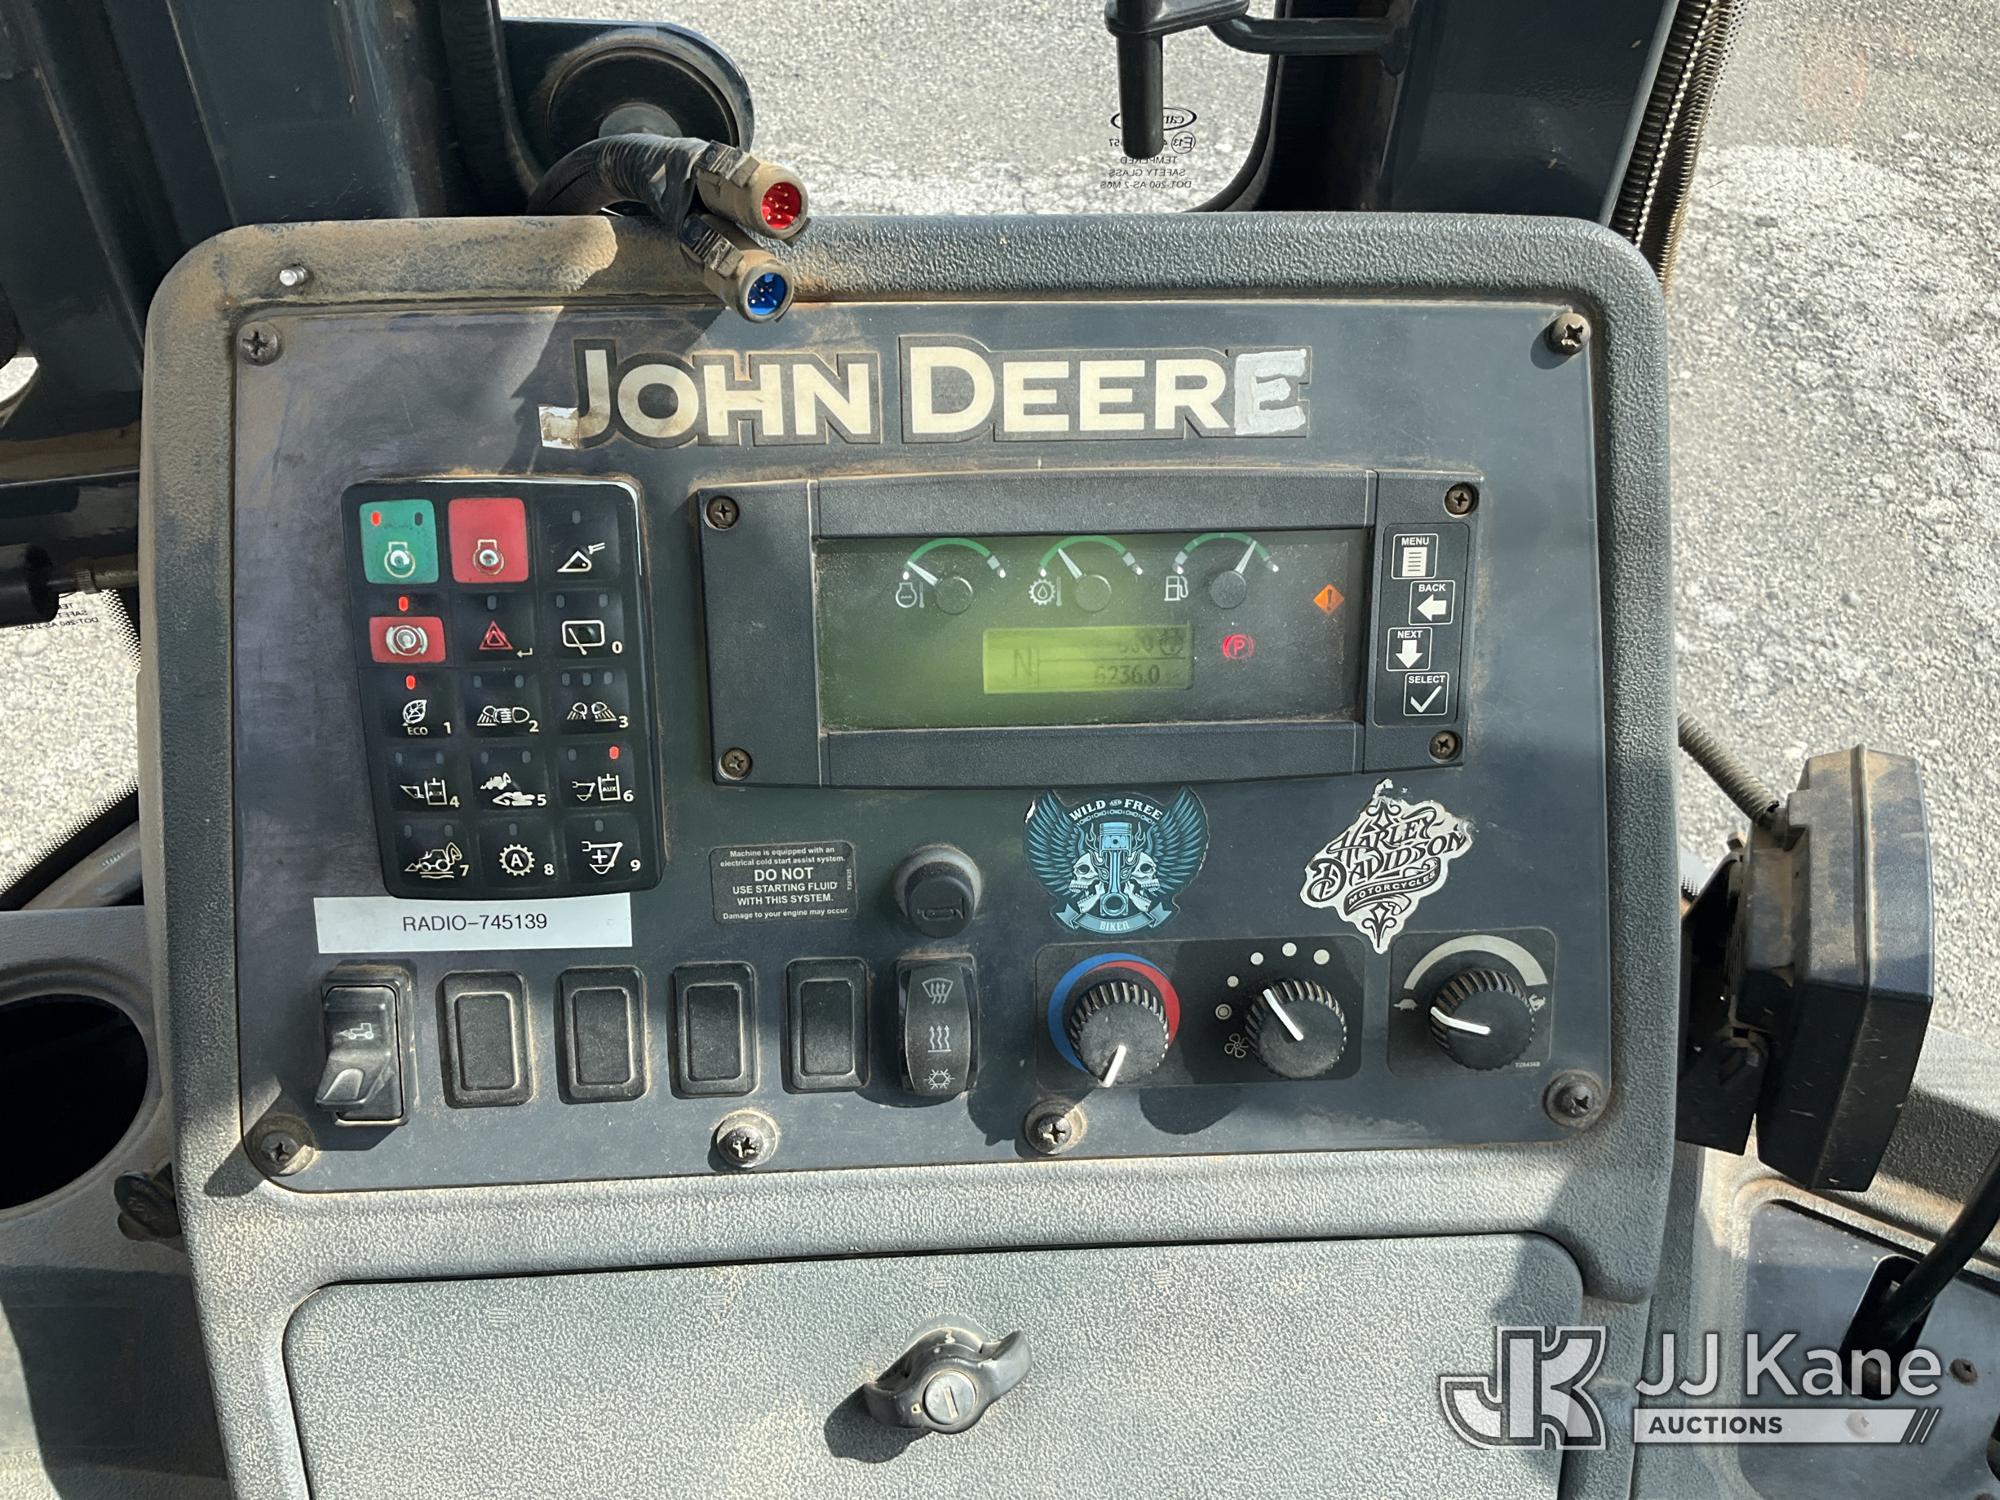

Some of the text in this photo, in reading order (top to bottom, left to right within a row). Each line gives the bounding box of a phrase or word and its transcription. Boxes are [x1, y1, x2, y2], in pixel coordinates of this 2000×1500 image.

[539, 345, 1308, 445] JOHN DEERE
[1401, 536, 1430, 546] MENU
[1418, 583, 1446, 593] BACK
[1397, 630, 1423, 639] NEXT
[611, 640, 623, 654] 0
[1408, 674, 1446, 684] SELECT
[443, 721, 452, 734] 1
[528, 720, 539, 733] 2
[618, 716, 629, 728] 3
[407, 726, 429, 736] ECO
[449, 795, 460, 808] 4
[537, 793, 547, 806] 5
[622, 789, 634, 802] 6
[1068, 800, 1106, 821] WILD
[1124, 798, 1163, 820] FREE
[1326, 806, 1443, 868] HARLEY
[729, 849, 762, 858] Machine
[763, 848, 770, 857] is
[771, 847, 807, 857] equipped
[808, 846, 824, 855] with
[629, 859, 641, 872] 9
[719, 855, 846, 868] electrical cold start assist system.
[1306, 826, 1467, 902] DAVIDSON
[459, 864, 470, 877] 7
[543, 863, 555, 876] 8
[754, 867, 814, 882] DO NOT
[732, 881, 838, 895] USE STARTING FLUID
[1347, 871, 1436, 906] MOTORCYCLES
[737, 893, 834, 906] WITH THIS SYSTEM.
[722, 912, 753, 921] Damage
[764, 911, 781, 919] your
[783, 909, 808, 918] engine
[809, 908, 825, 917] may
[826, 907, 848, 915] occur
[402, 913, 548, 932] RADIO-745139
[1100, 920, 1130, 931] BIKER
